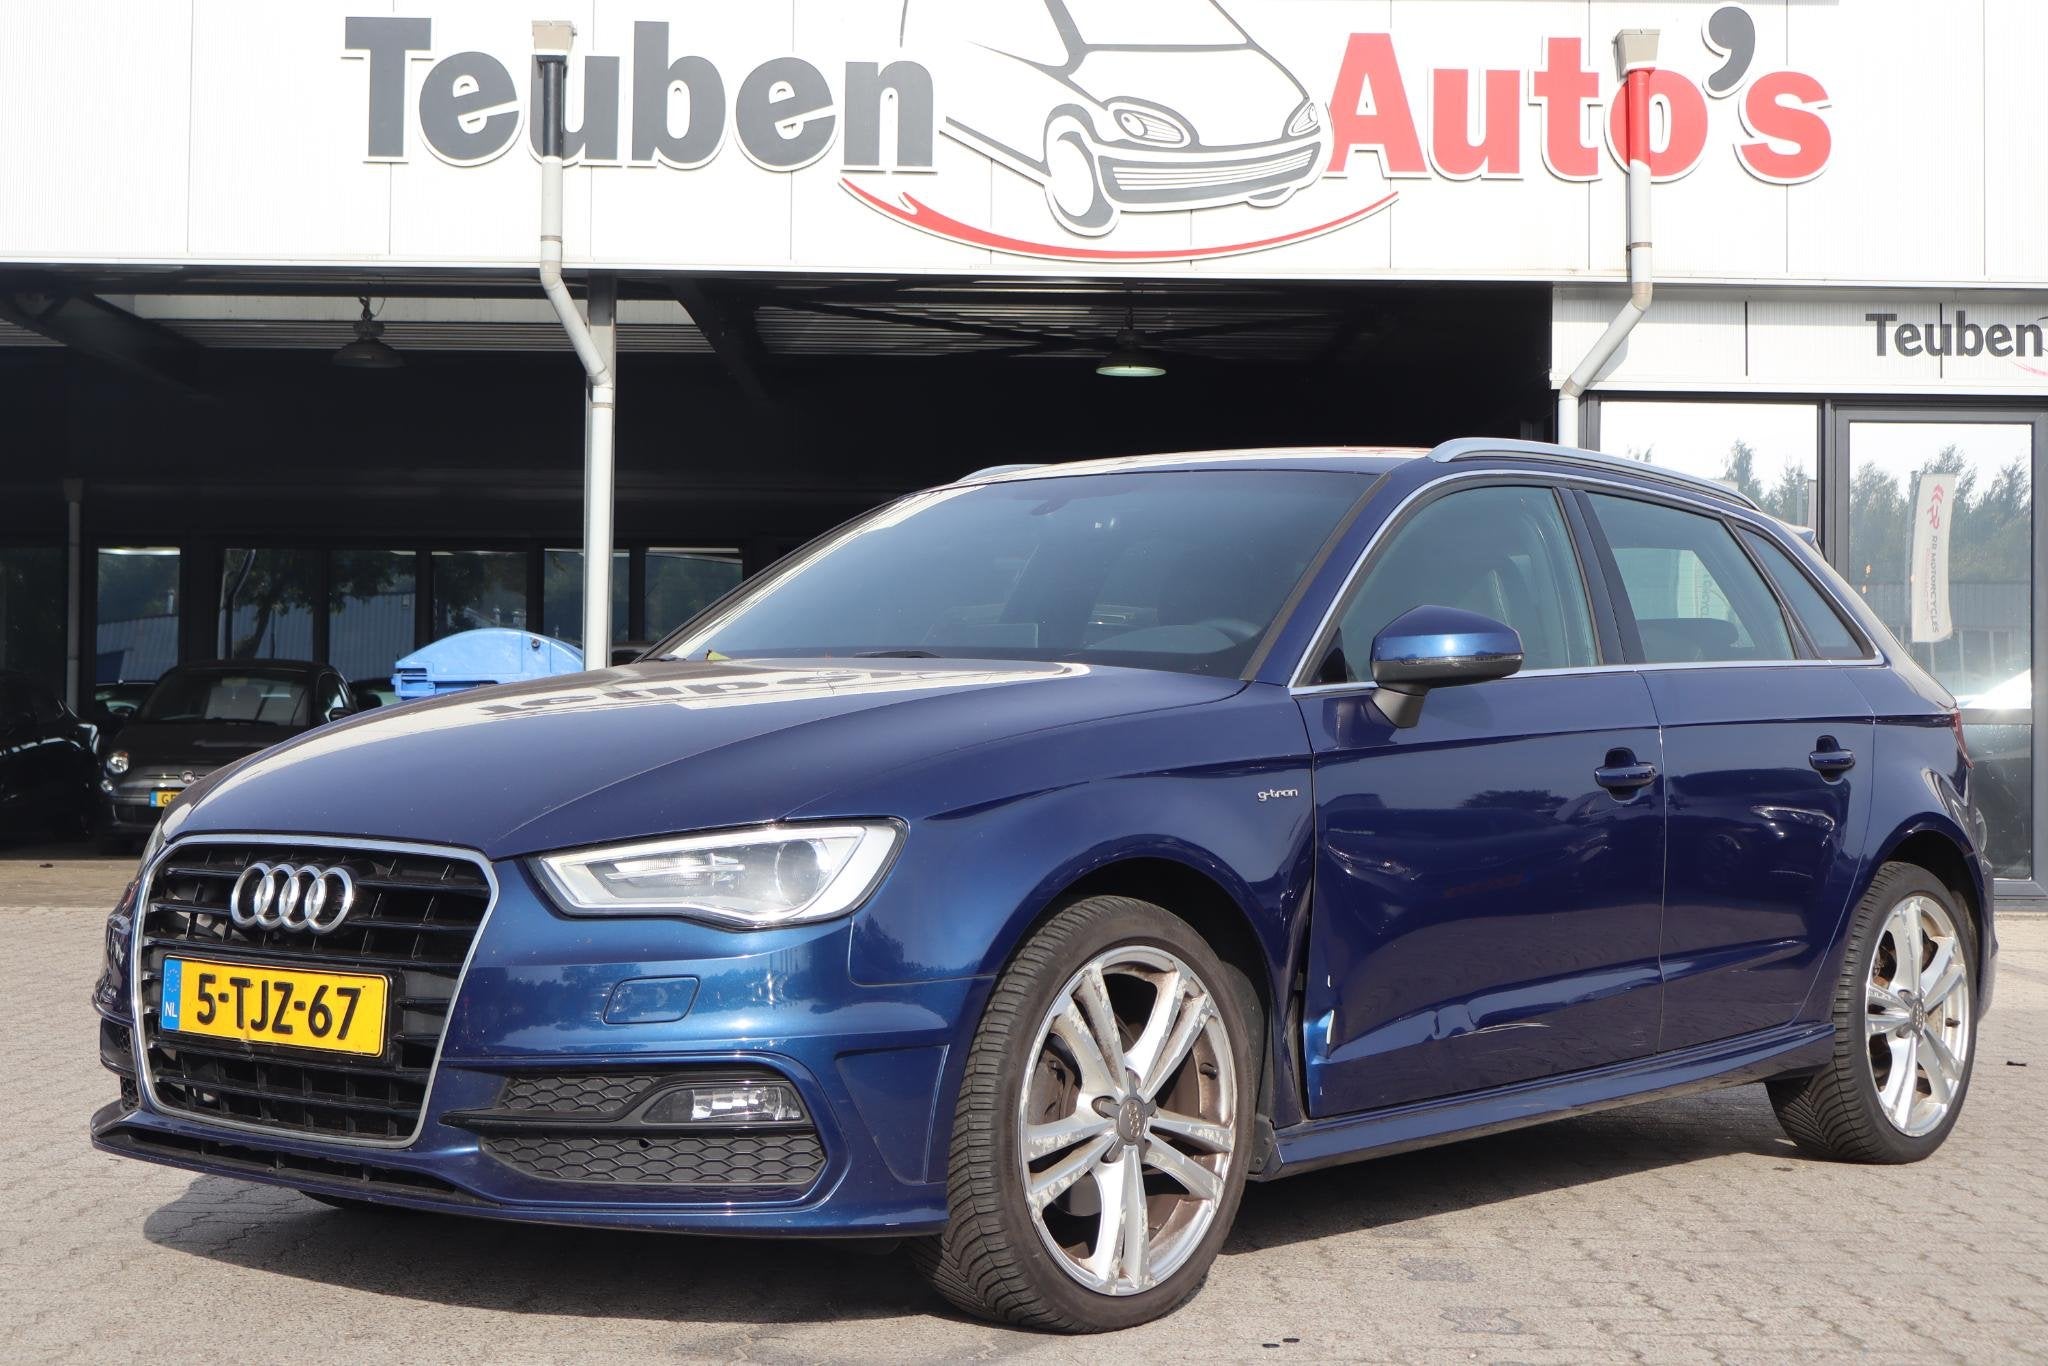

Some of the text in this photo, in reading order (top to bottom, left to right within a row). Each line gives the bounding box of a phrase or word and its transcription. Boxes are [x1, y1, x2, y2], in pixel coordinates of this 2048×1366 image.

[344, 6, 1832, 178] Teuben Auto's
[1865, 310, 2043, 357] Teuben
[1930, 552, 1940, 633] MOTORCYCLES
[1257, 788, 1298, 802] g-tron
[164, 1002, 178, 1019] NL
[197, 973, 362, 1041] 5-TJZ-67
